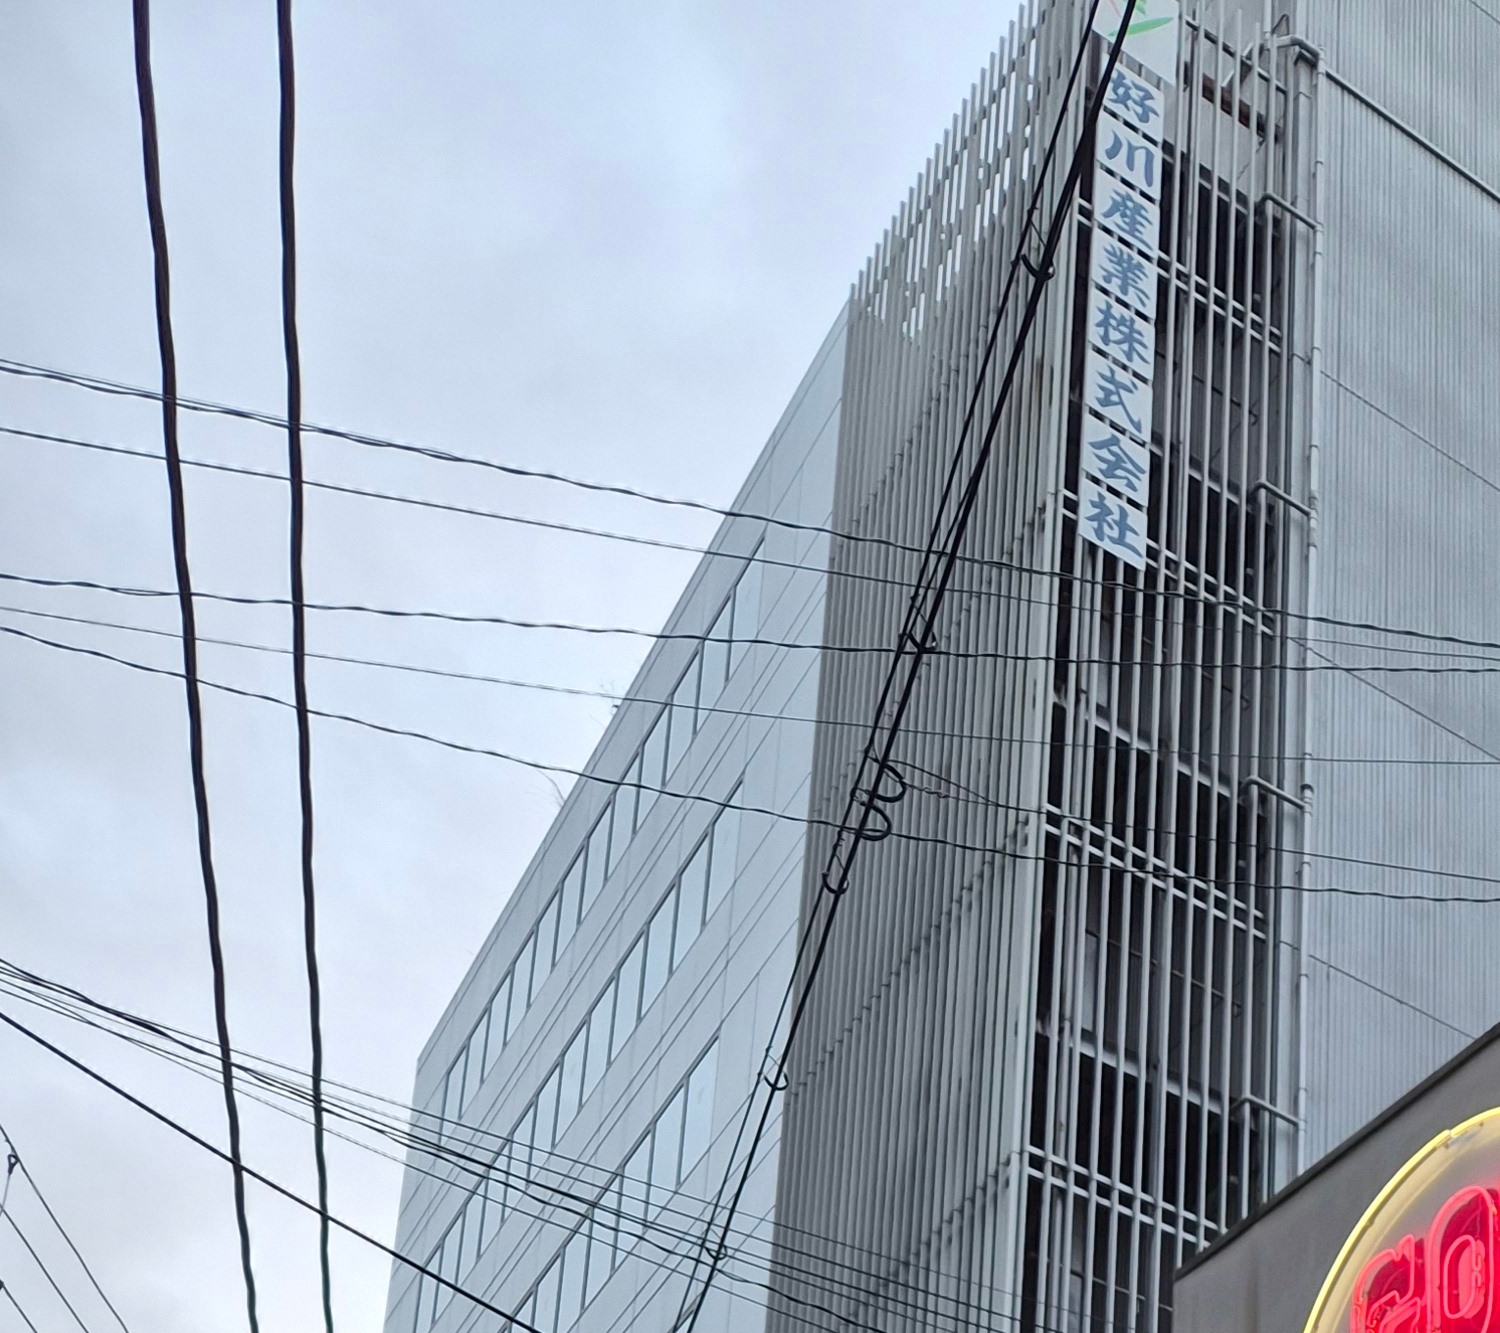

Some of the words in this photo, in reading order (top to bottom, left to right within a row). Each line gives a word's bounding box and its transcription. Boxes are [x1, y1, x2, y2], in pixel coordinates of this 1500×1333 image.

[1084, 66, 1160, 561] 好川産業株式会社
